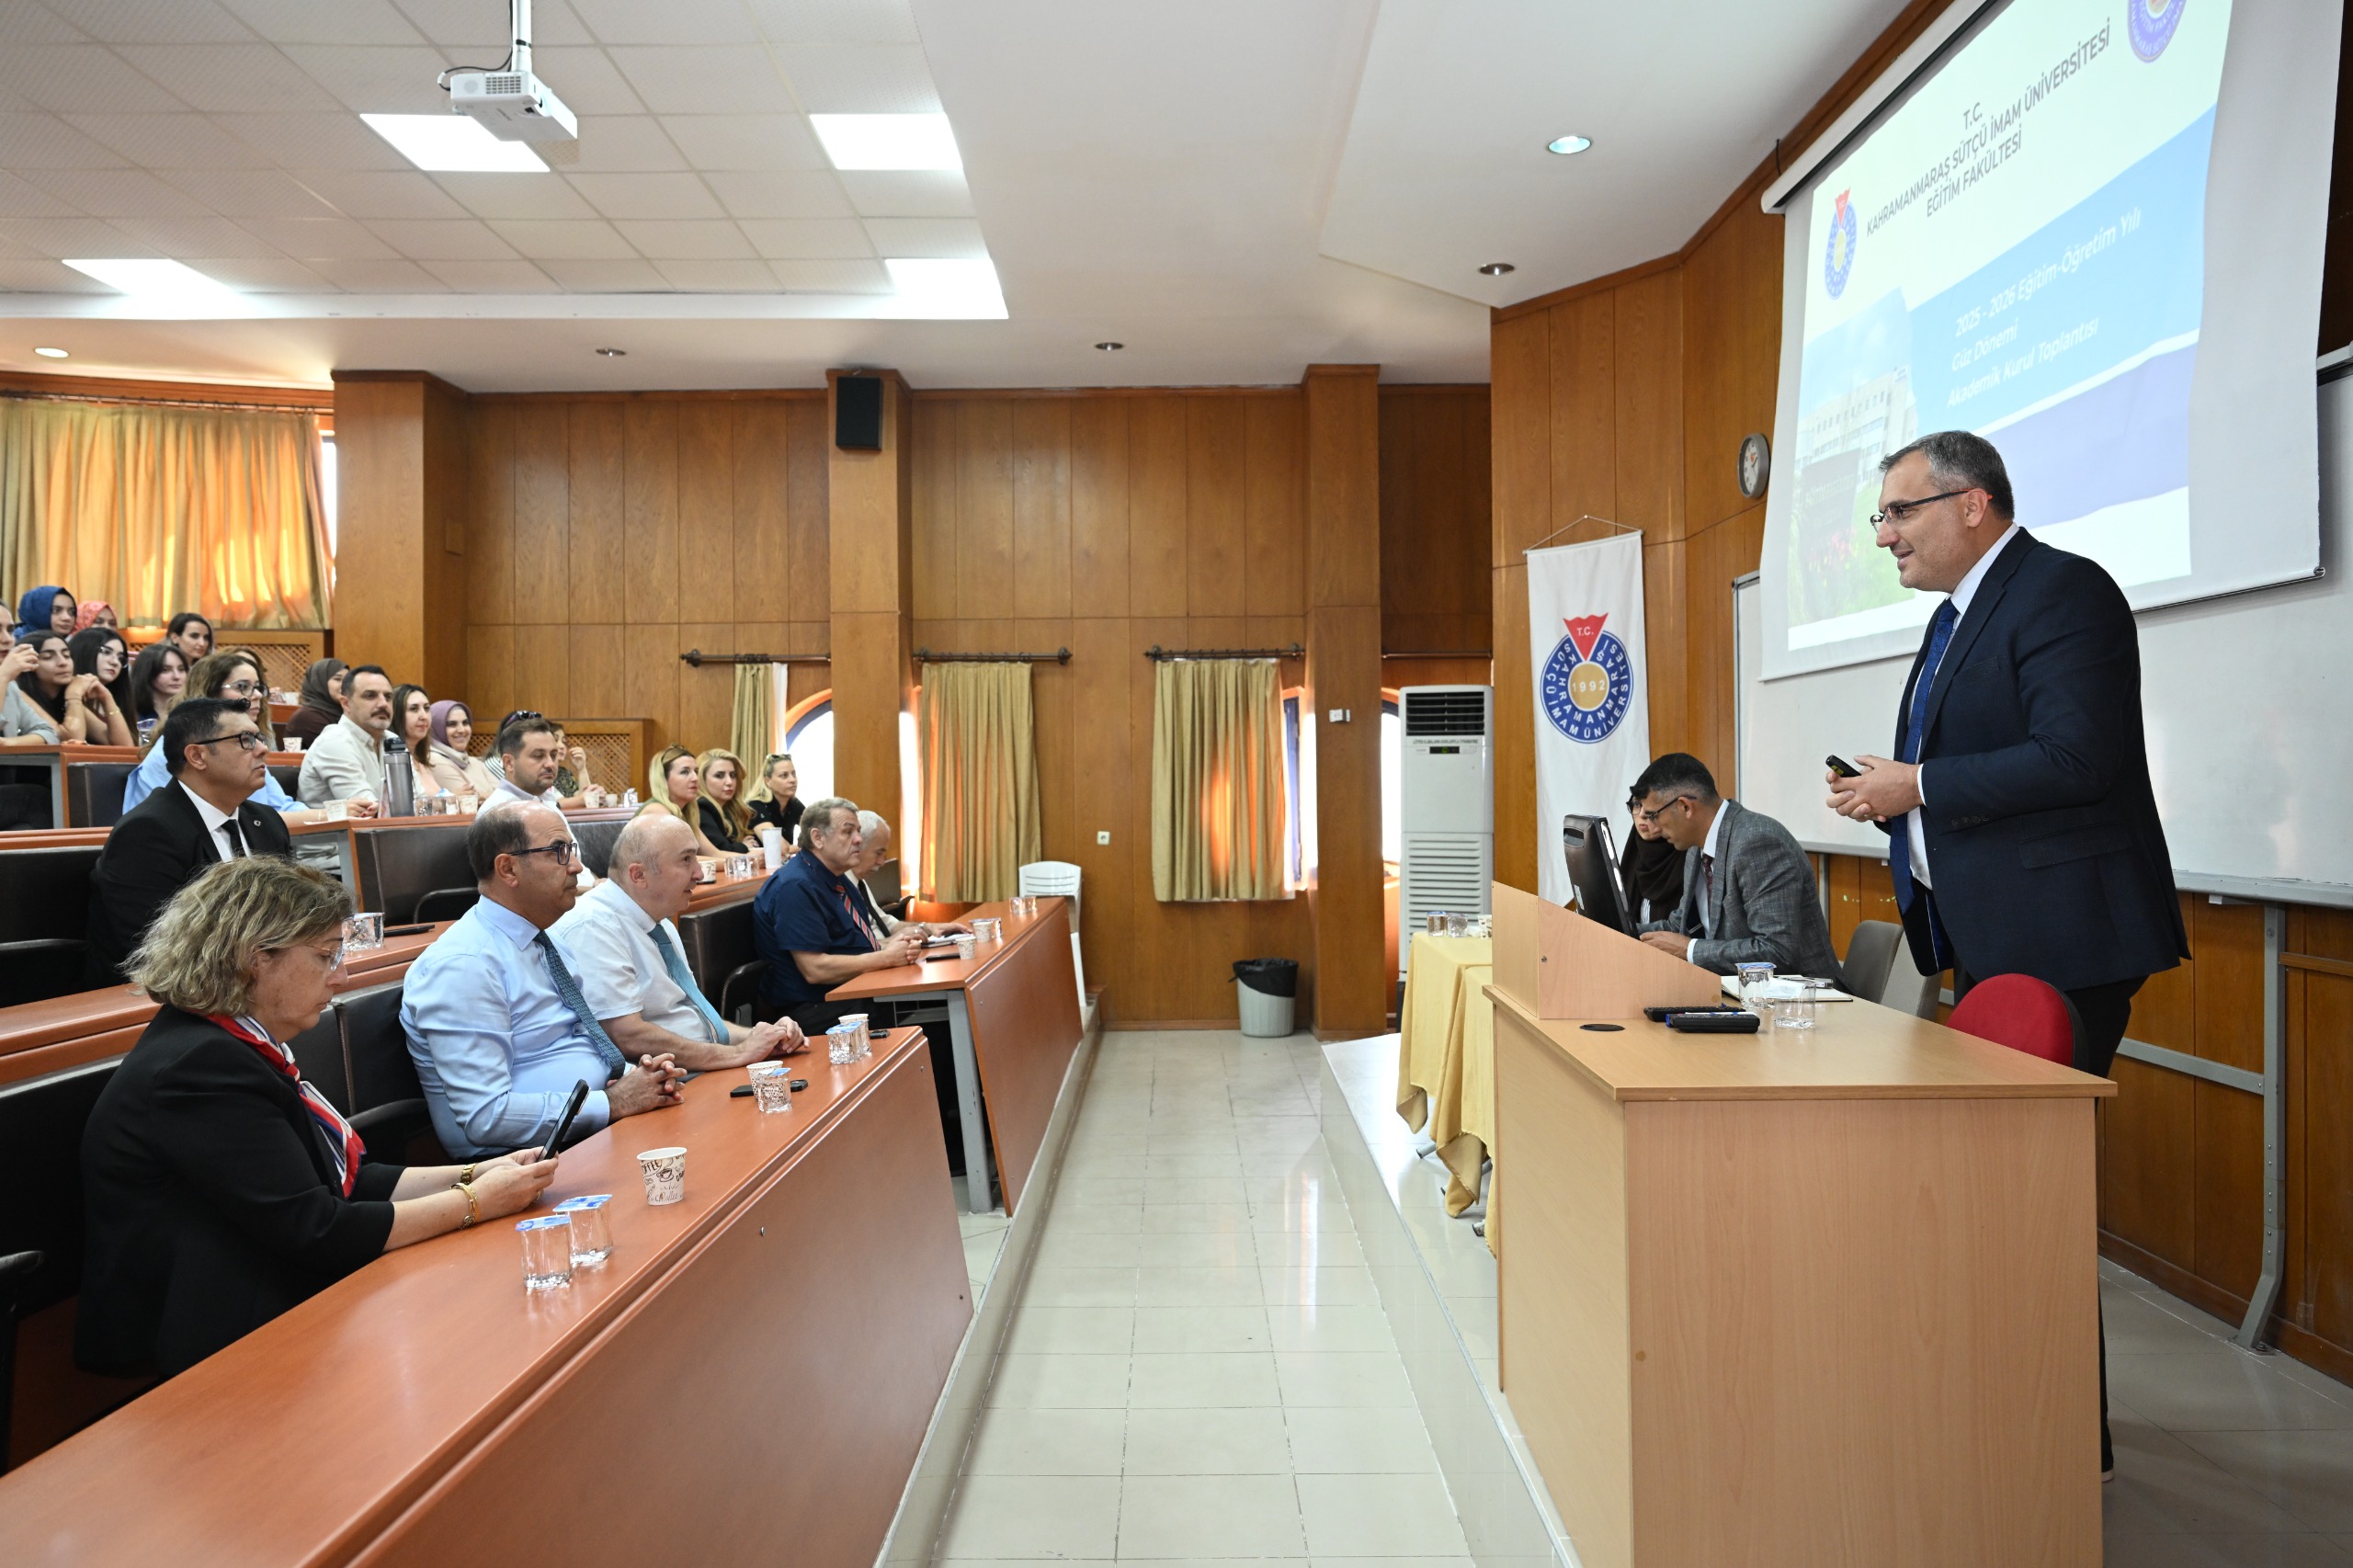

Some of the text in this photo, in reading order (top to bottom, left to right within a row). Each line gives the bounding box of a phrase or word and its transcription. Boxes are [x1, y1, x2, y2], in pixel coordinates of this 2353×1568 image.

[1867, 17, 2110, 238] KAHRAMANMARAŞ SÜTÇÜ İMAM ÜNİVERSİTESİ
[1963, 101, 1983, 131] T.C.
[1927, 122, 2022, 218] EĞİTİM FAKÜLTESİ
[1955, 305, 1981, 338] 2025
[1988, 284, 2017, 318] 2026
[2018, 226, 2116, 301] Eğitim-Öğretim
[2120, 206, 2141, 238] Yılı
[1947, 317, 2099, 409] Akademik Kurul Toplantısı
[1951, 316, 2018, 372] Güz Dönemi
[1576, 626, 1595, 637] T.C.
[1558, 649, 1619, 724] KAHRAMANMARAŞ
[1572, 679, 1607, 693] 1992
